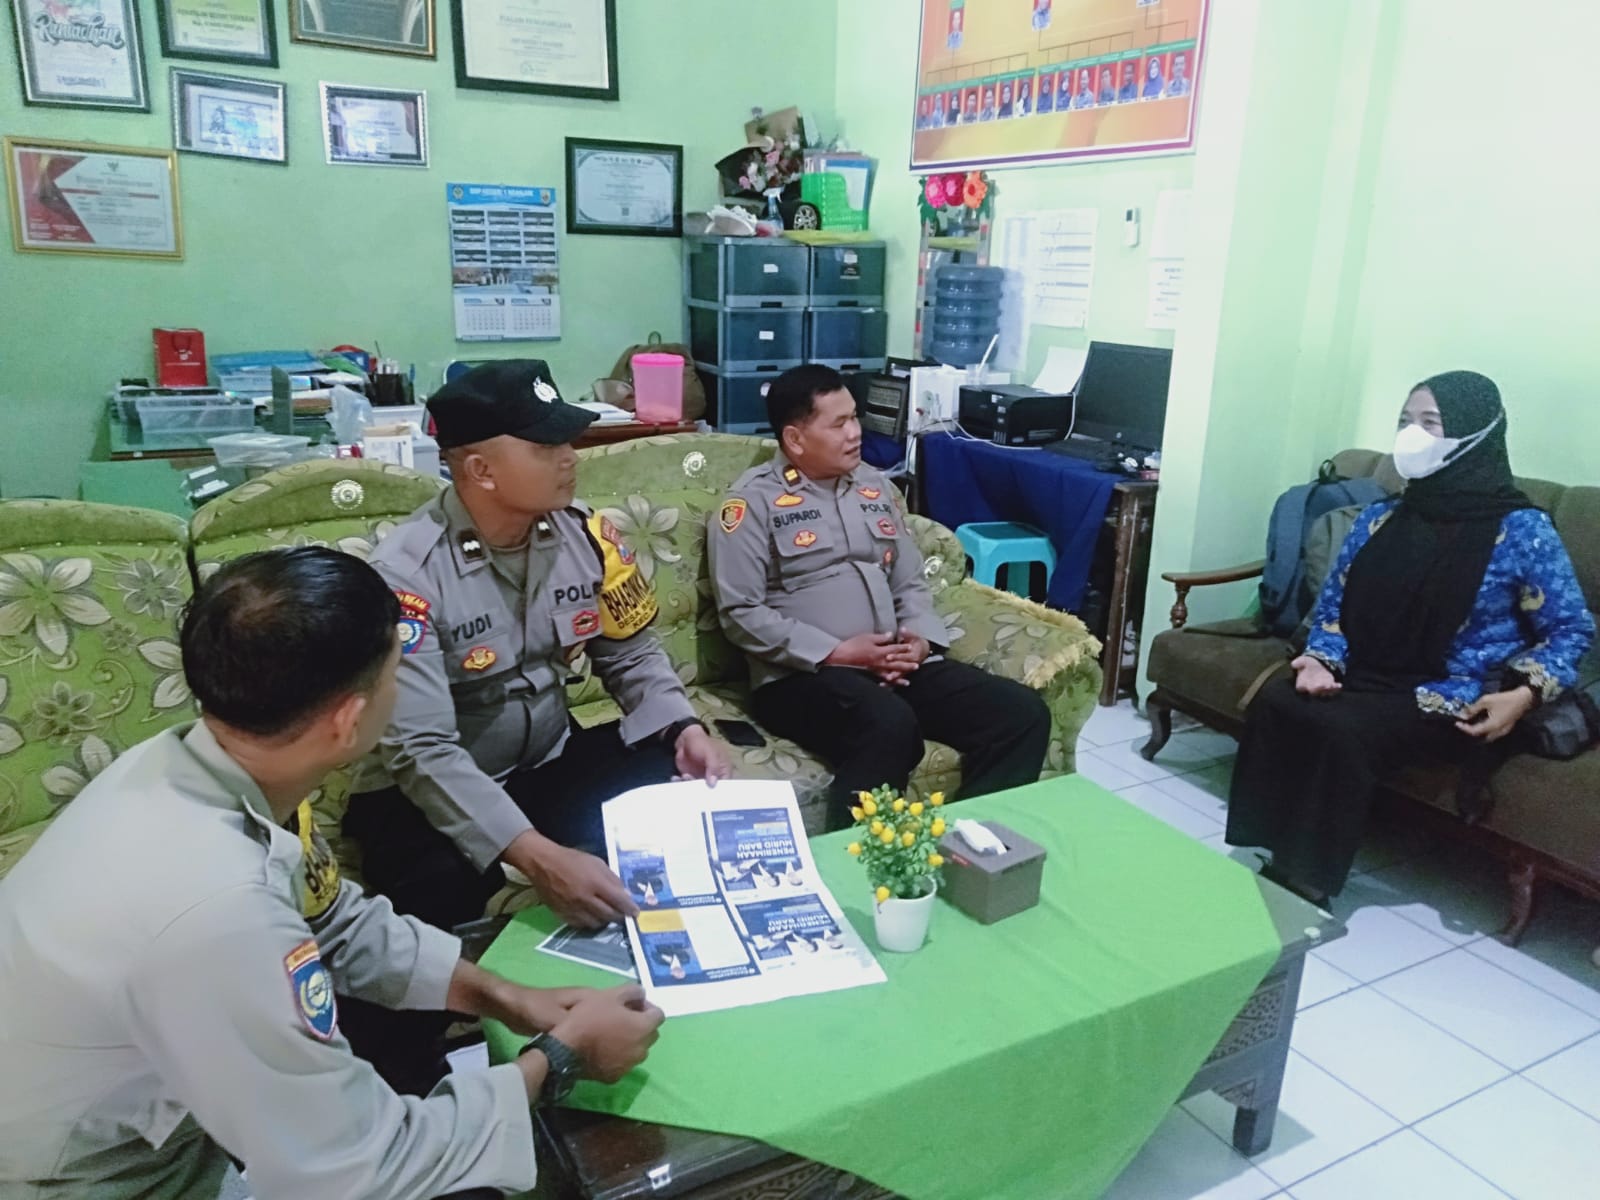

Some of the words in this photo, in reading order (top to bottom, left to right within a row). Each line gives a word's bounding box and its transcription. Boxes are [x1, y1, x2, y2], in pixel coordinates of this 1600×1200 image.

[773, 509, 822, 528] SUPARDI
[451, 613, 492, 642] YUDI
[737, 842, 763, 852] BARU
[764, 839, 793, 849] MURID
[736, 847, 796, 859] PENERIMAAN
